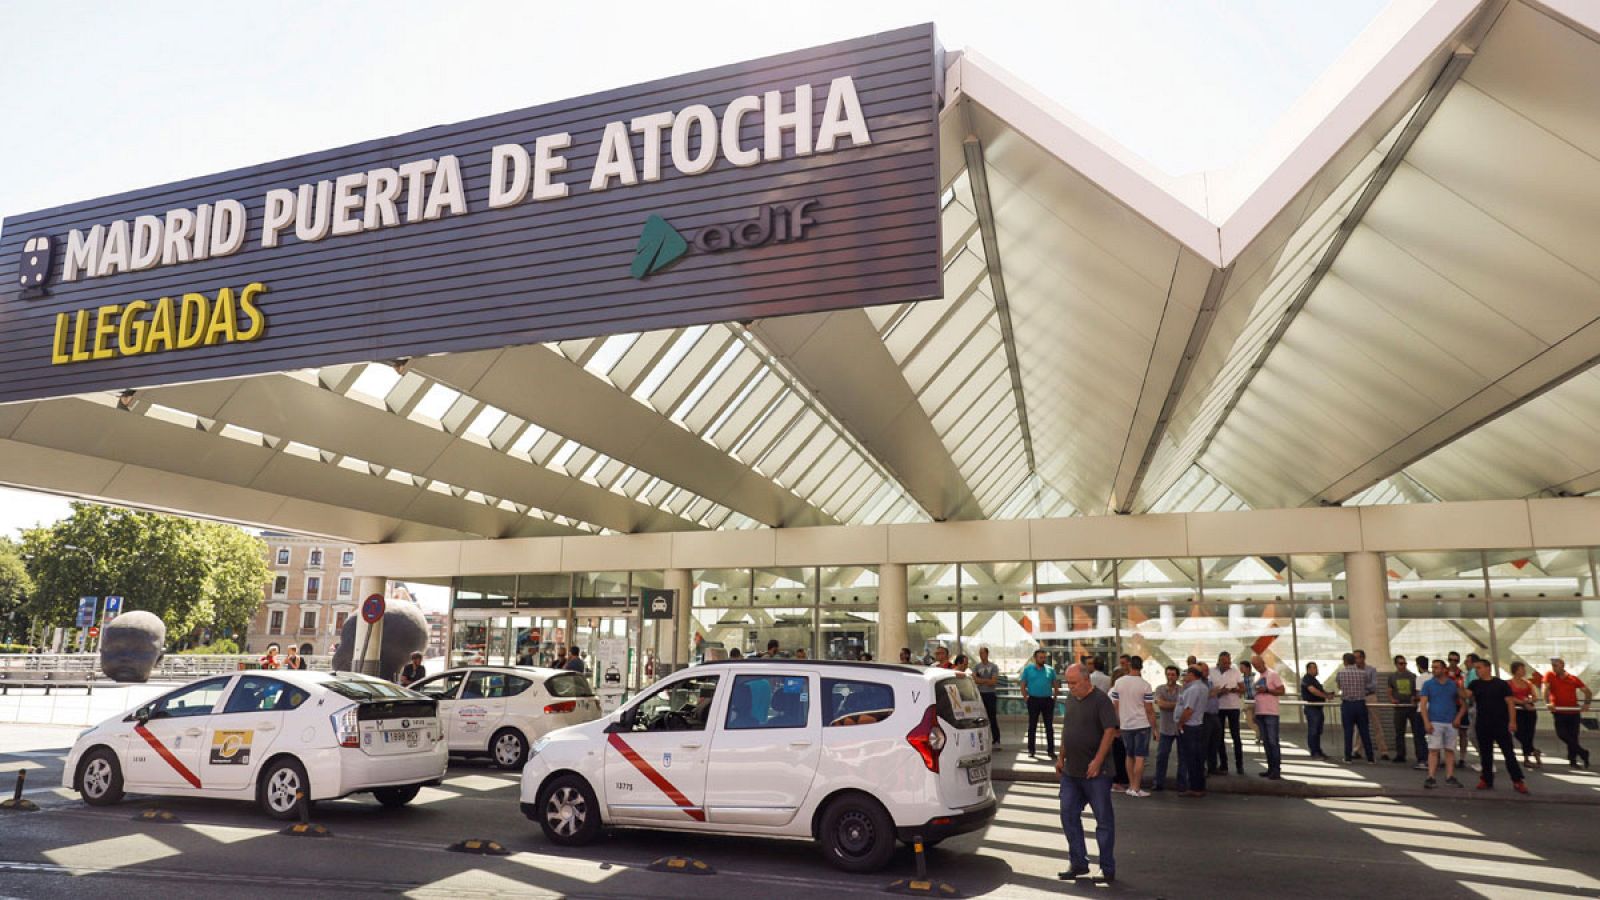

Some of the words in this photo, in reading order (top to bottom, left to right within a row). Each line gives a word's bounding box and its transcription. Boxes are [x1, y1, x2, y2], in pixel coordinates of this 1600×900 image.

[62, 199, 248, 281] MADRID
[261, 155, 468, 248] PUERTA
[488, 131, 572, 209] DE
[589, 75, 872, 191] ATOCHA
[694, 200, 820, 253] adif
[51, 282, 269, 365] LLEGADAS
